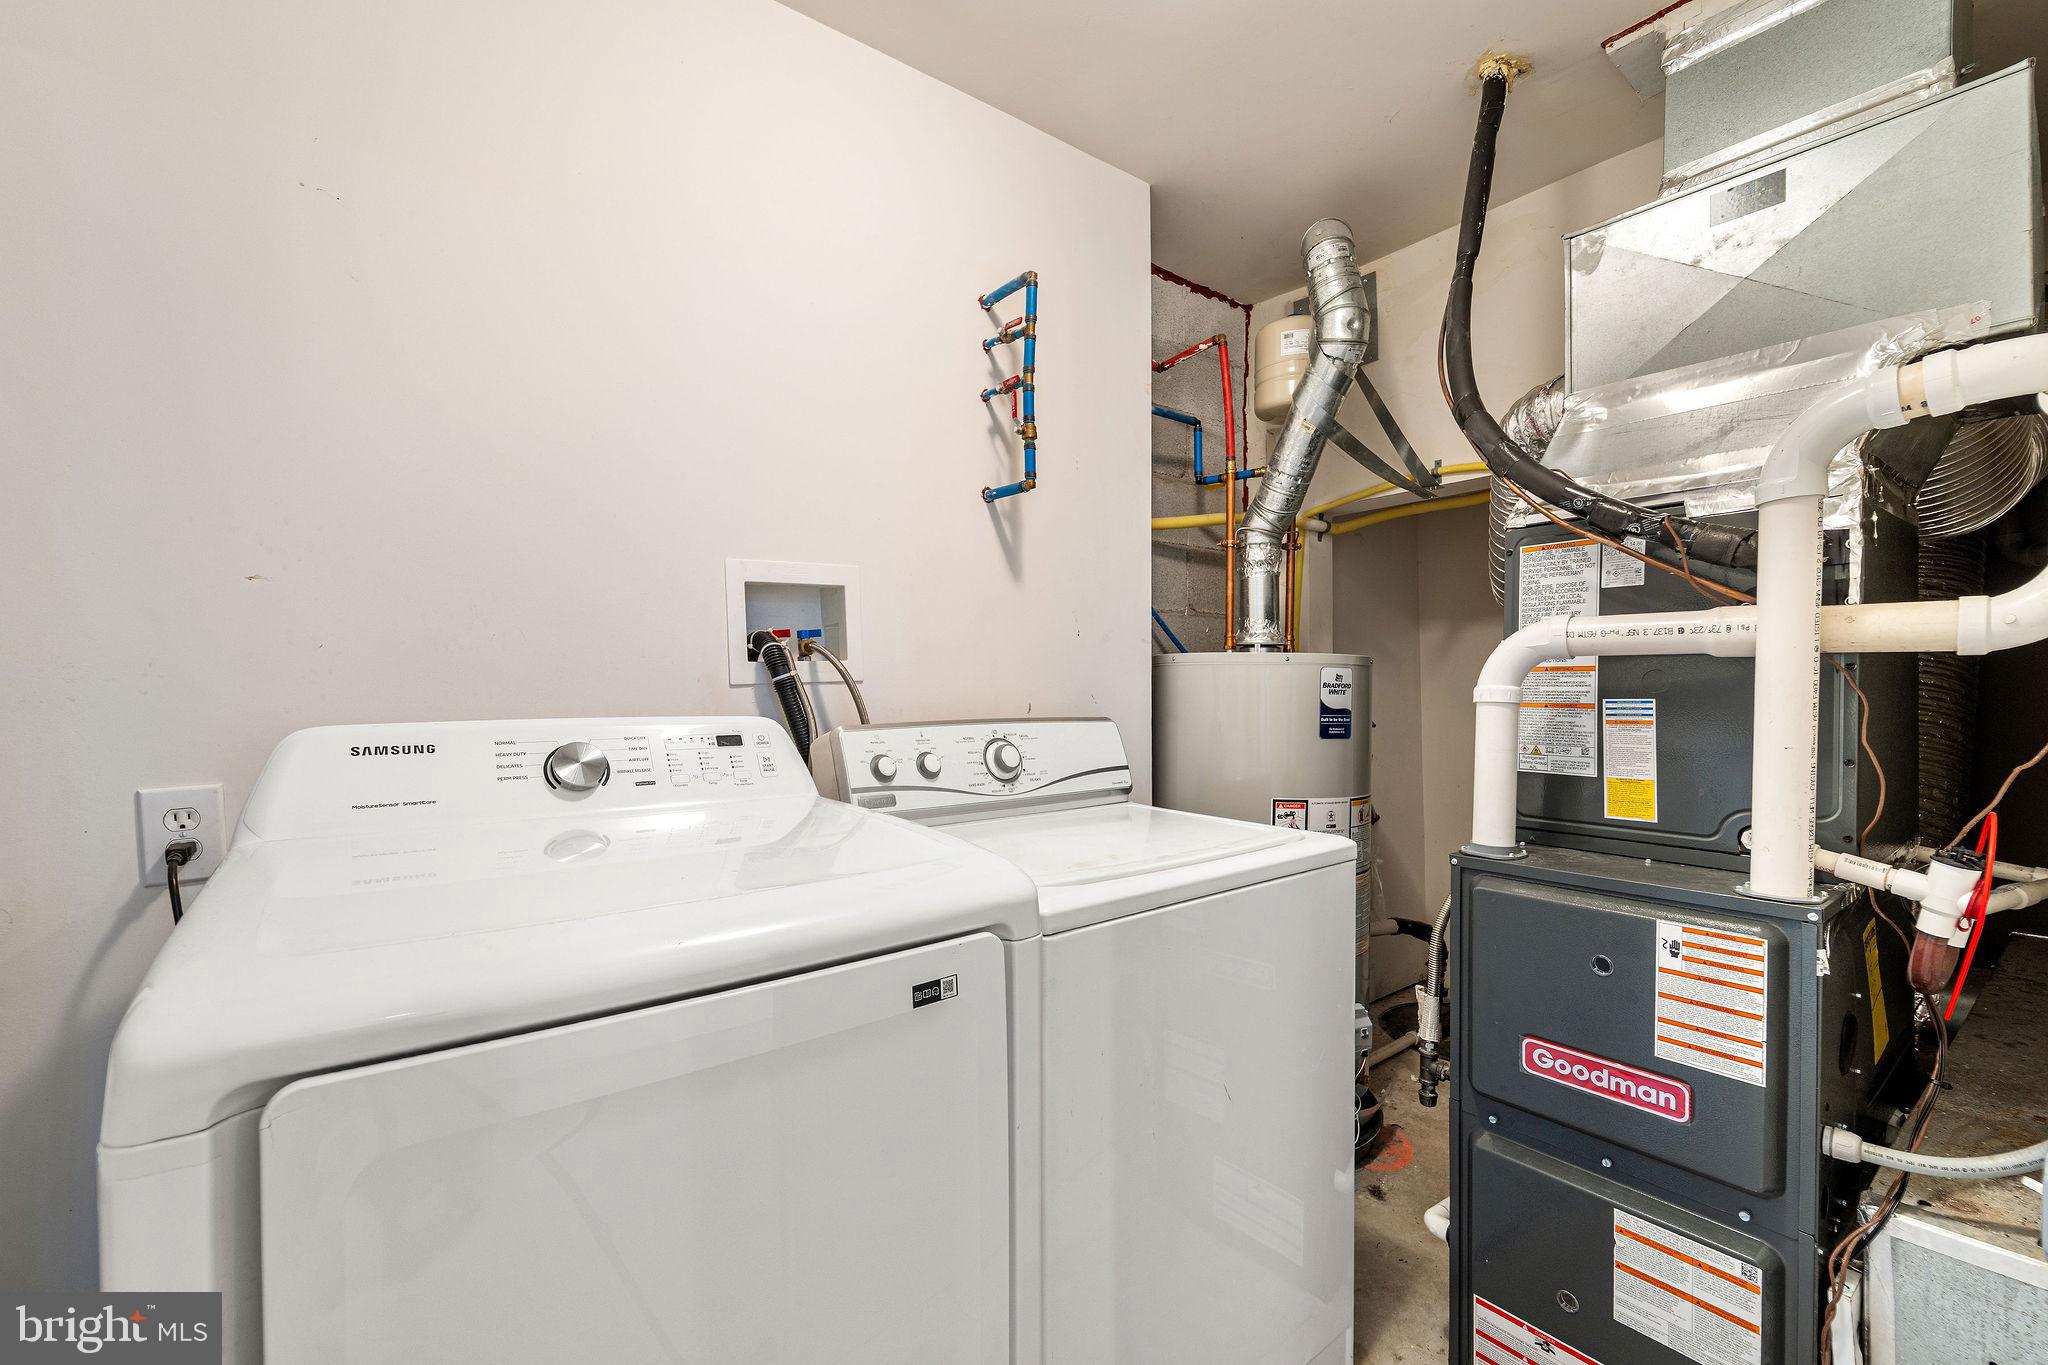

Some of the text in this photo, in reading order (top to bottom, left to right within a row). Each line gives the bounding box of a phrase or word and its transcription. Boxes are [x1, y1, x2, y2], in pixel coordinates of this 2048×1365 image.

[1322, 682, 1352, 690] BRADFORD
[1328, 689, 1347, 697] WHITE
[350, 743, 437, 758] SAMSUNG
[351, 799, 437, 811] MoistureSensor SmartCare
[1532, 1047, 1677, 1112] Goodman
